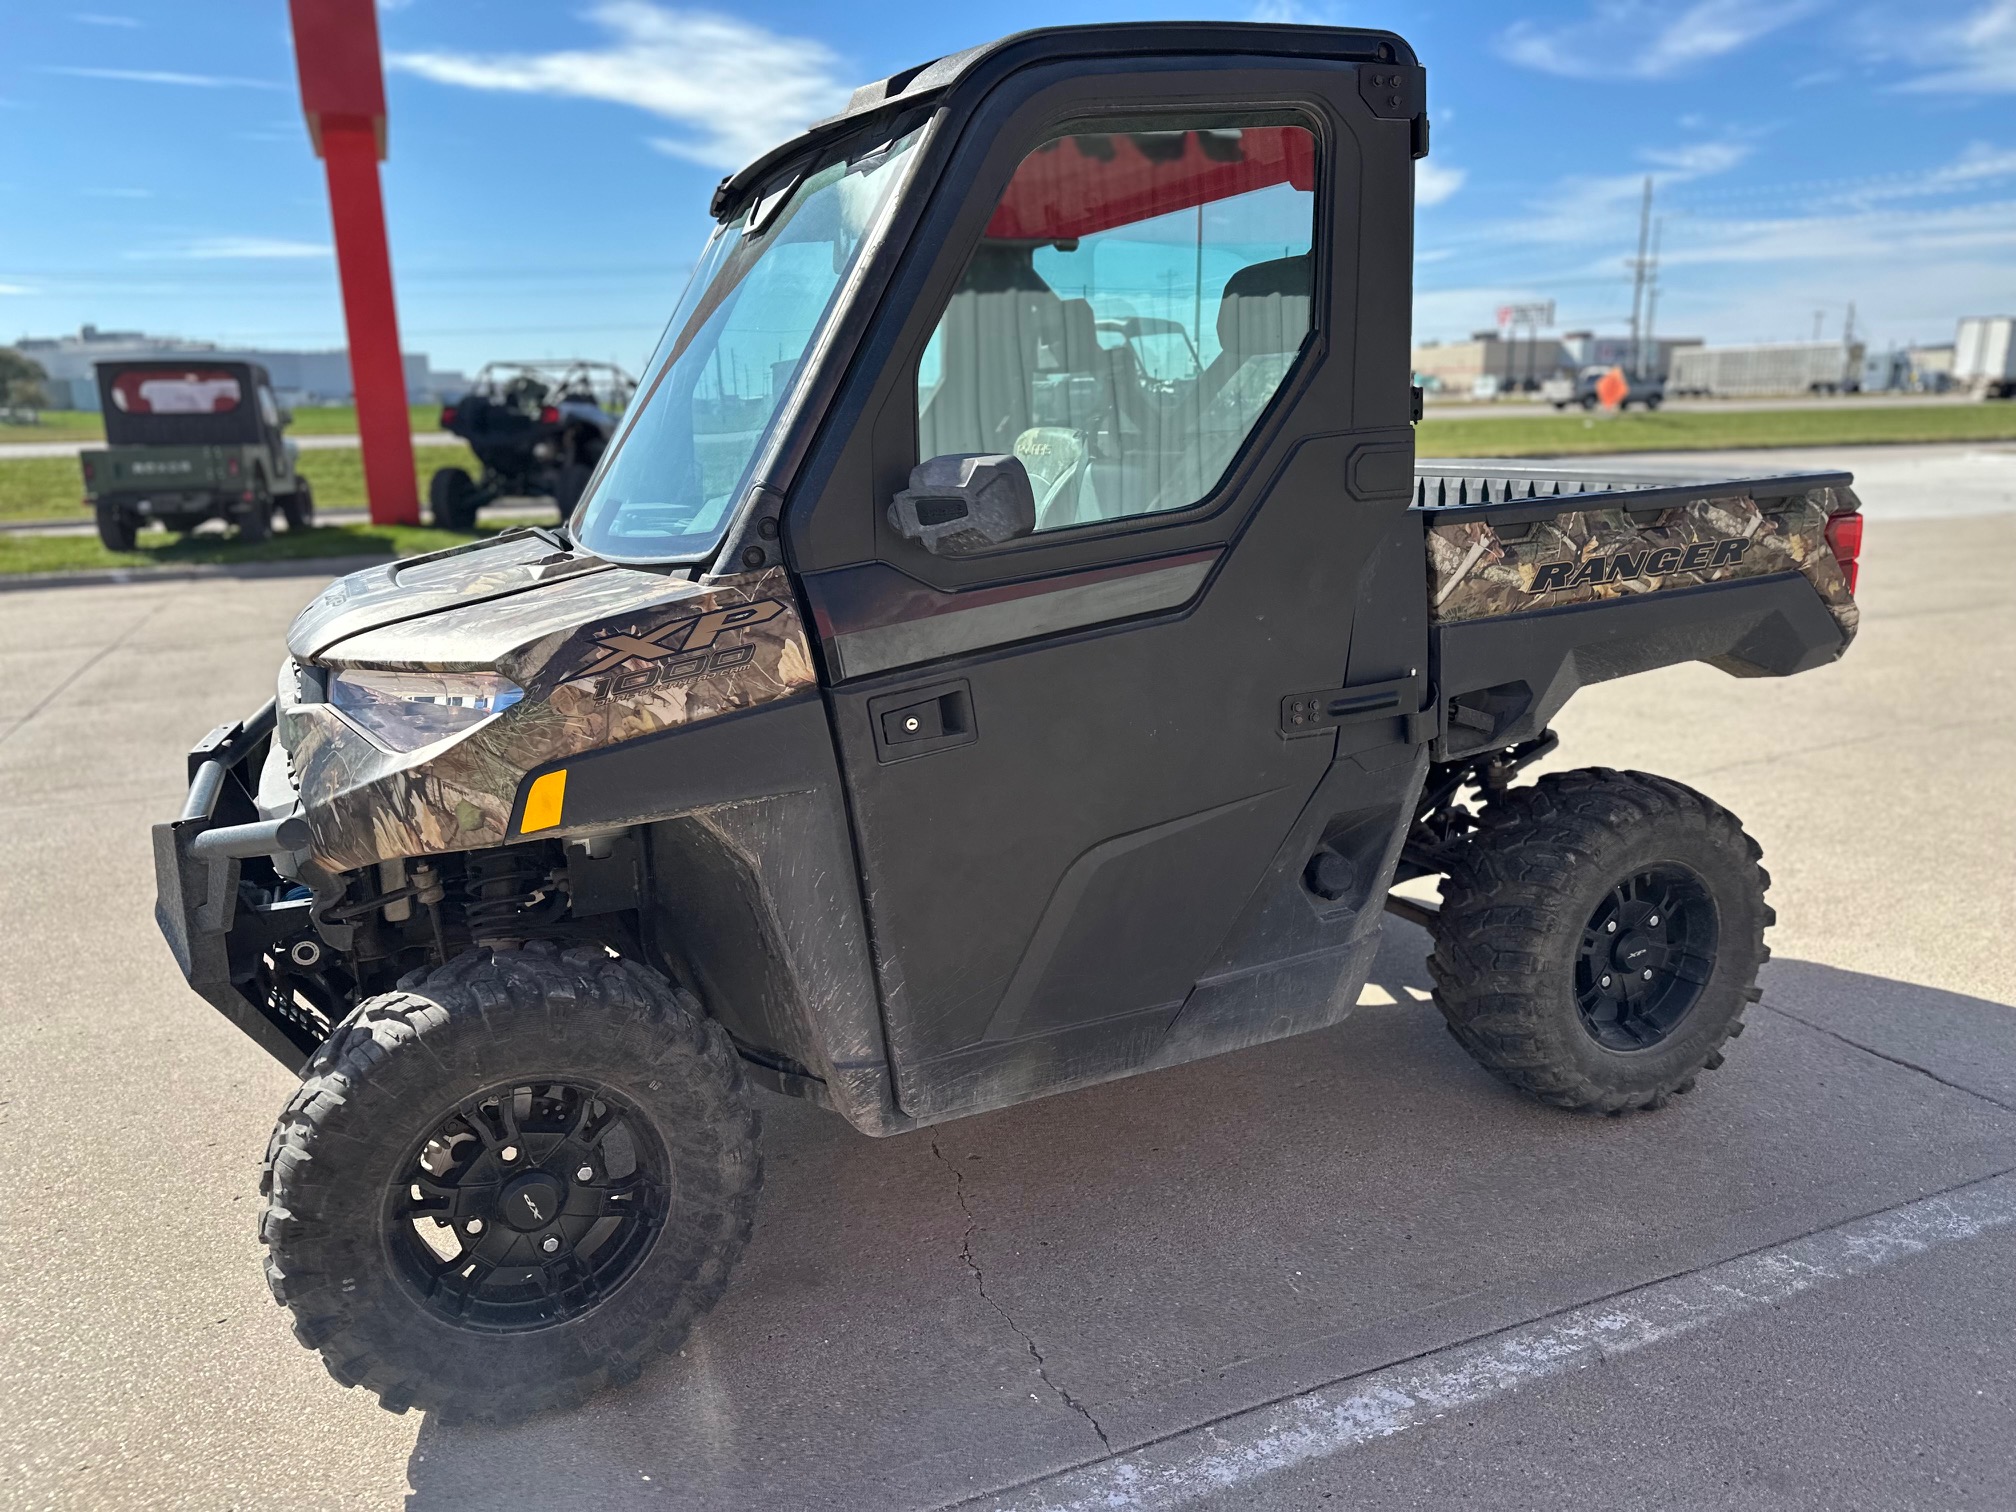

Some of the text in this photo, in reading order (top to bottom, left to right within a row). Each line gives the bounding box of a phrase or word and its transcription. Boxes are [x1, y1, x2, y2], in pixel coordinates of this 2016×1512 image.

[1528, 537, 1751, 594] RANGER
[553, 599, 788, 684] XP
[594, 643, 756, 700] 1000
[594, 664, 752, 708] DUAL OVERHEAD CAM
[523, 1193, 544, 1220] XP
